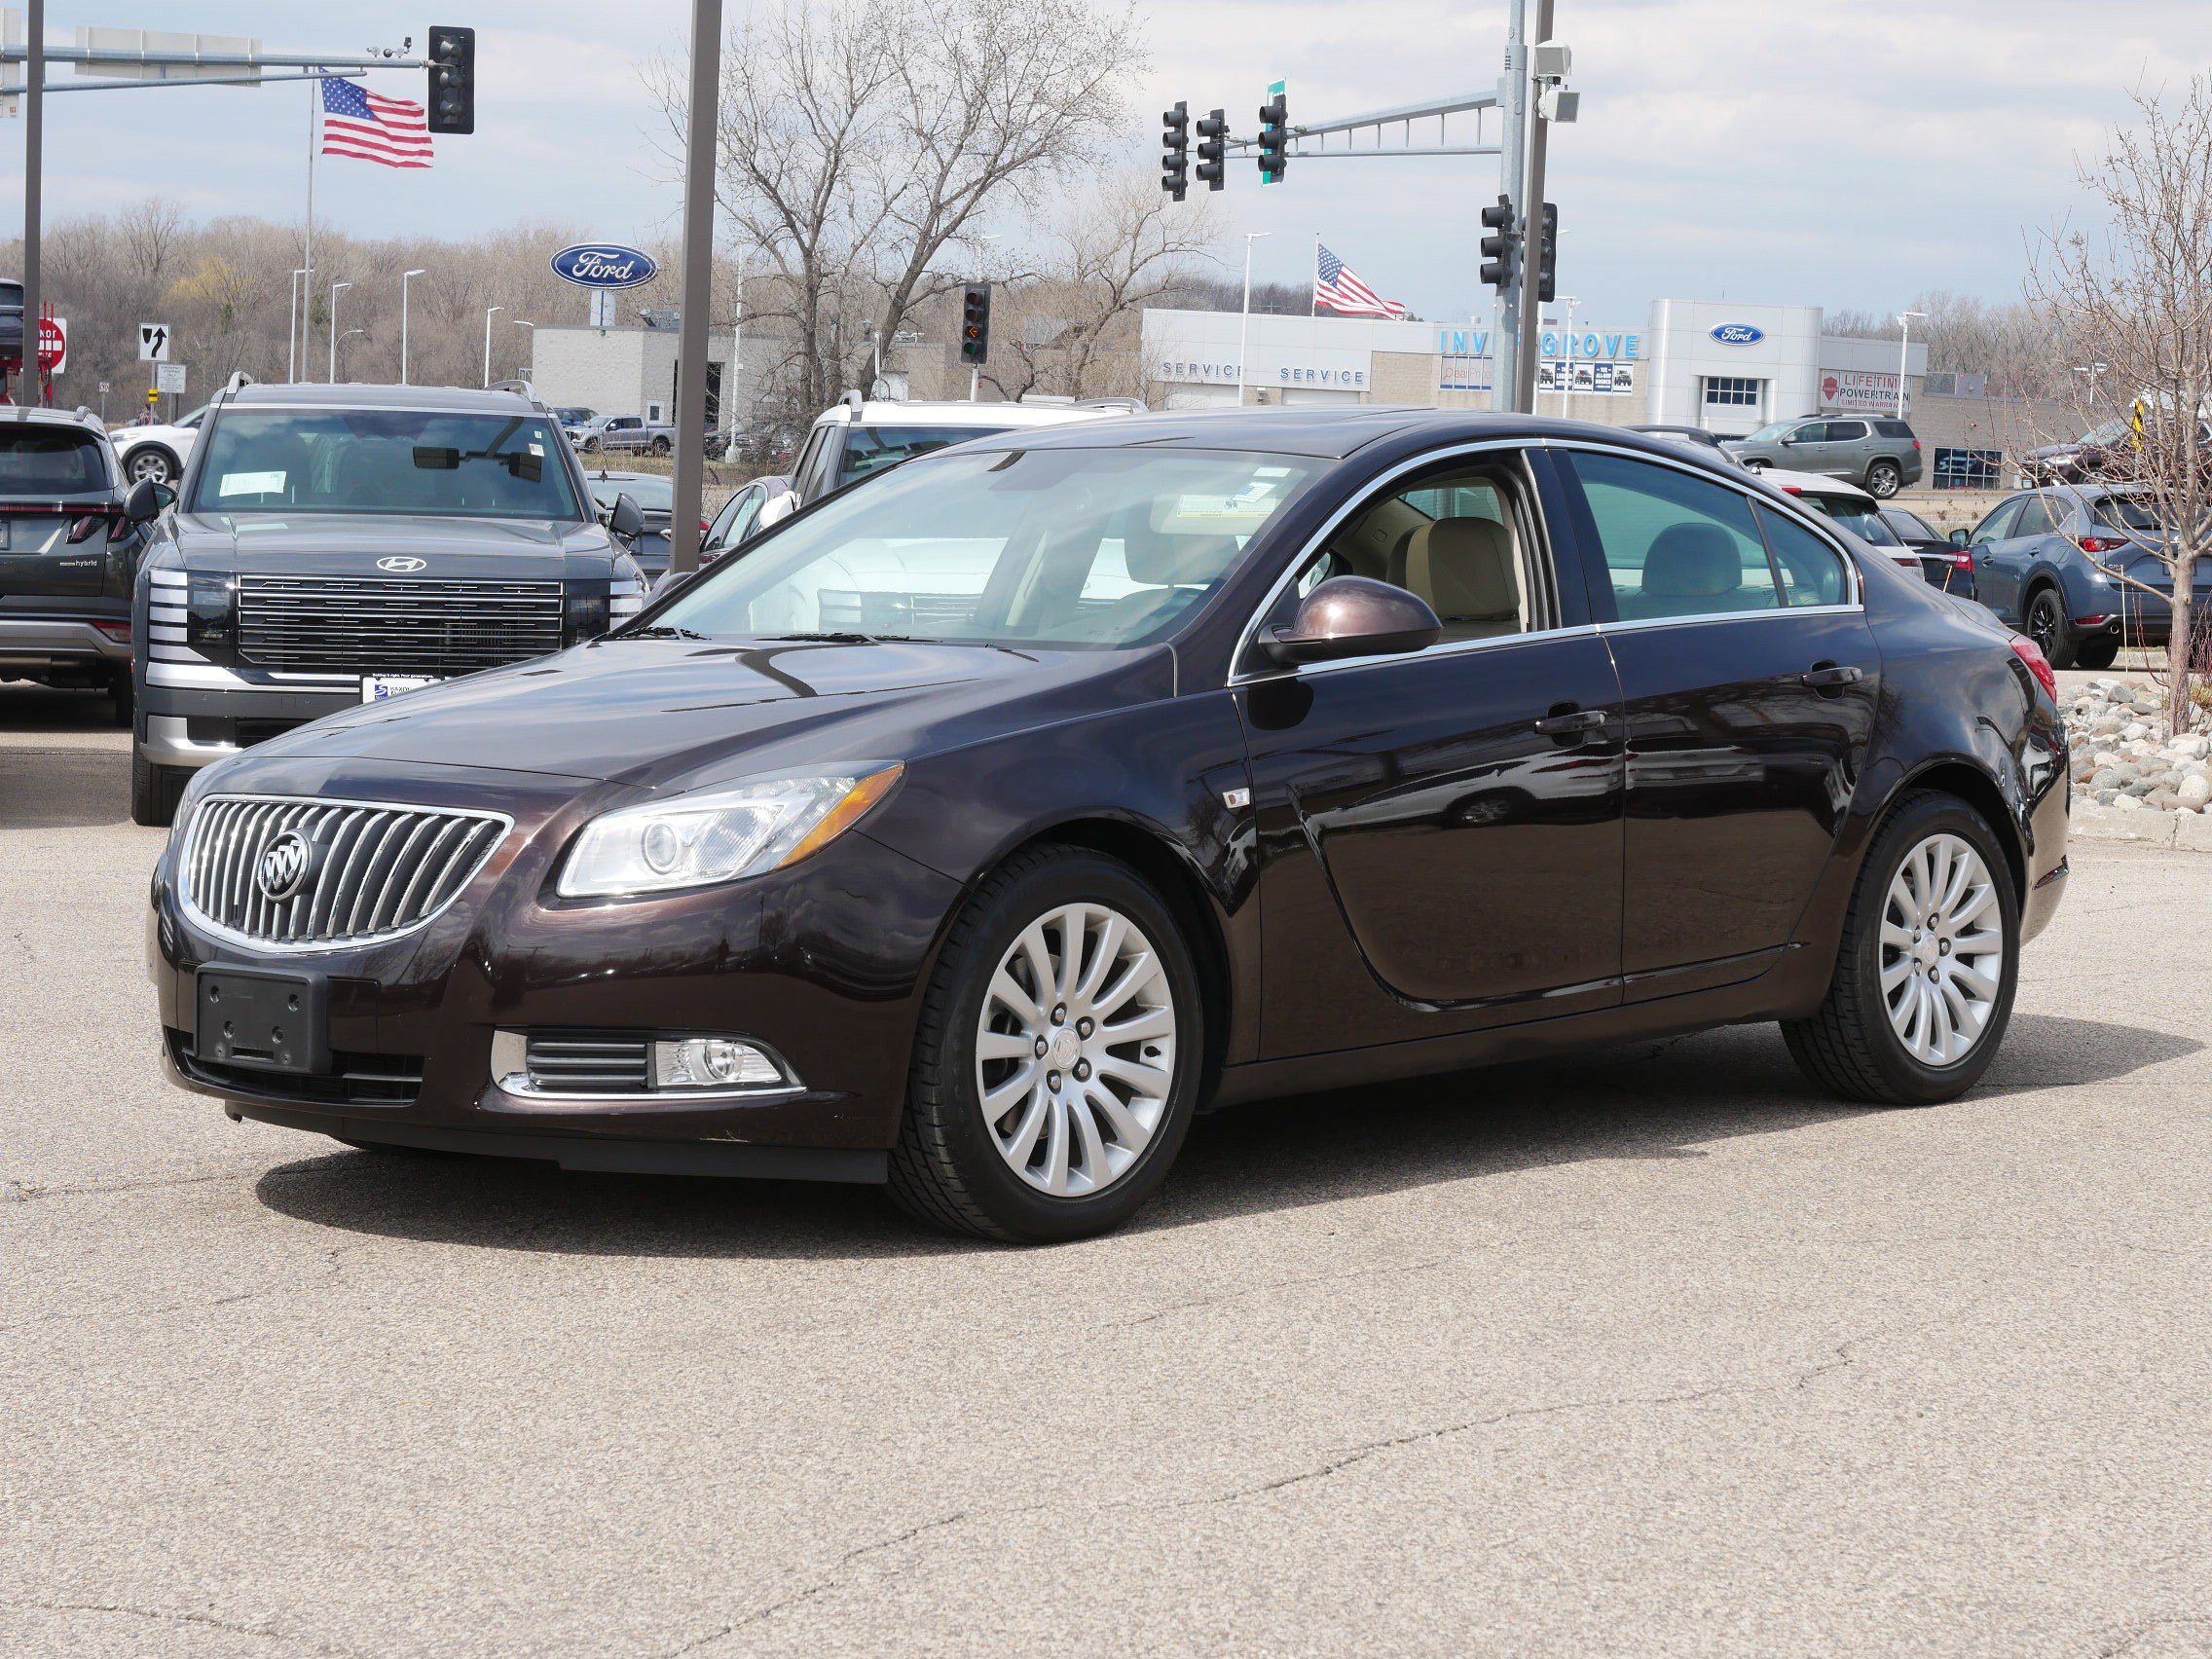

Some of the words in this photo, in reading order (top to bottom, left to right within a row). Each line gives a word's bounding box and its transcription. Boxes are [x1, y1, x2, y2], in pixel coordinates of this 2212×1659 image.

[572, 251, 635, 279] Ford
[1721, 327, 1752, 342] Ford
[1541, 332, 1639, 357] GROVE
[1280, 368, 1364, 384] SERVICE
[1845, 374, 1906, 388] LIFETIM
[1840, 388, 1909, 400] POWERTRAN
